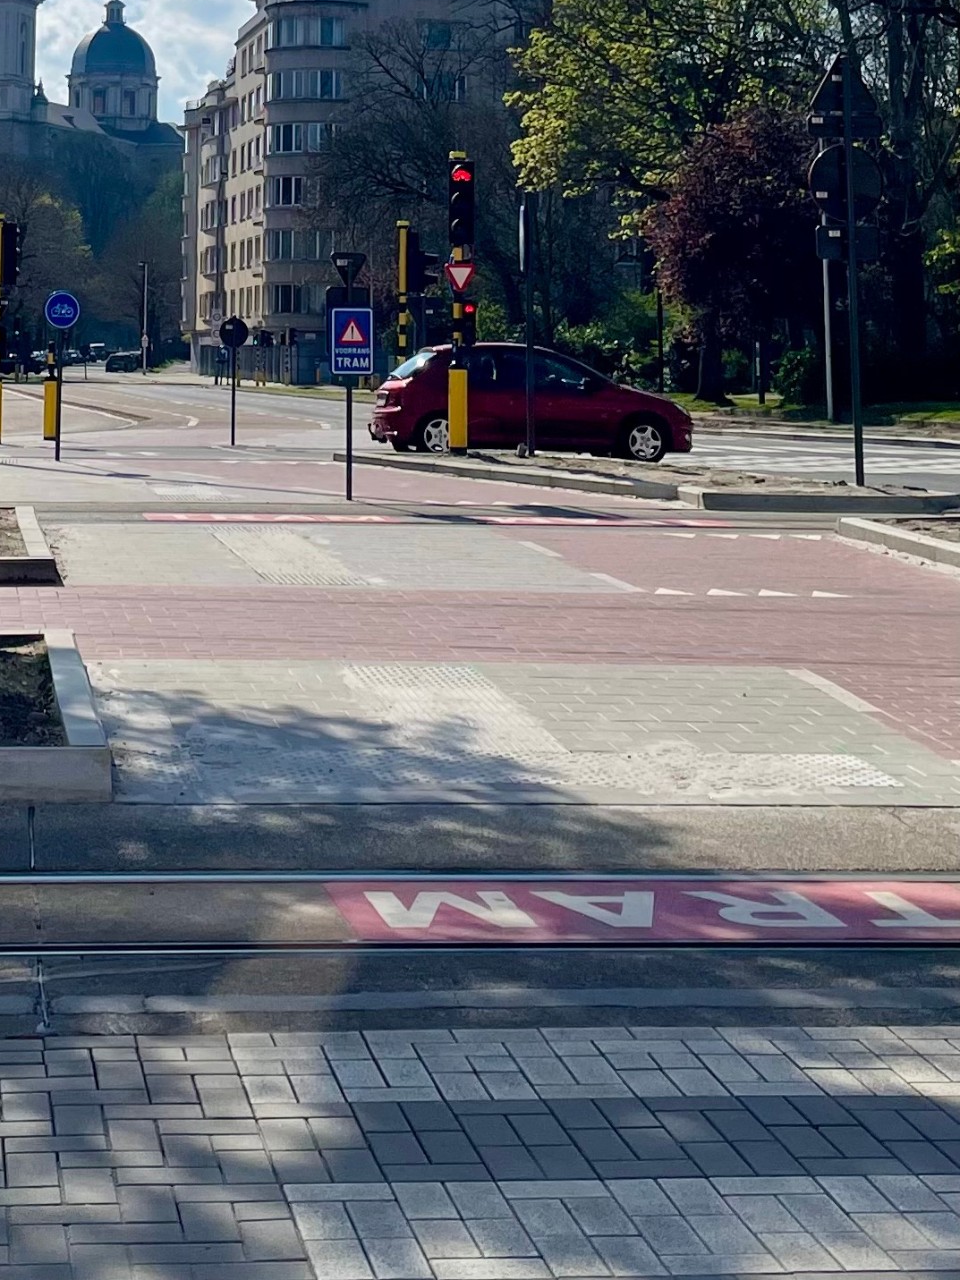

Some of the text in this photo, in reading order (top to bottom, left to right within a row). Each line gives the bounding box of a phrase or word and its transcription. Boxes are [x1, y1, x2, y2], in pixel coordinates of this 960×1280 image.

[335, 347, 371, 355] VOORRANG
[336, 357, 370, 368] TRAM
[362, 890, 960, 928] TRAM
